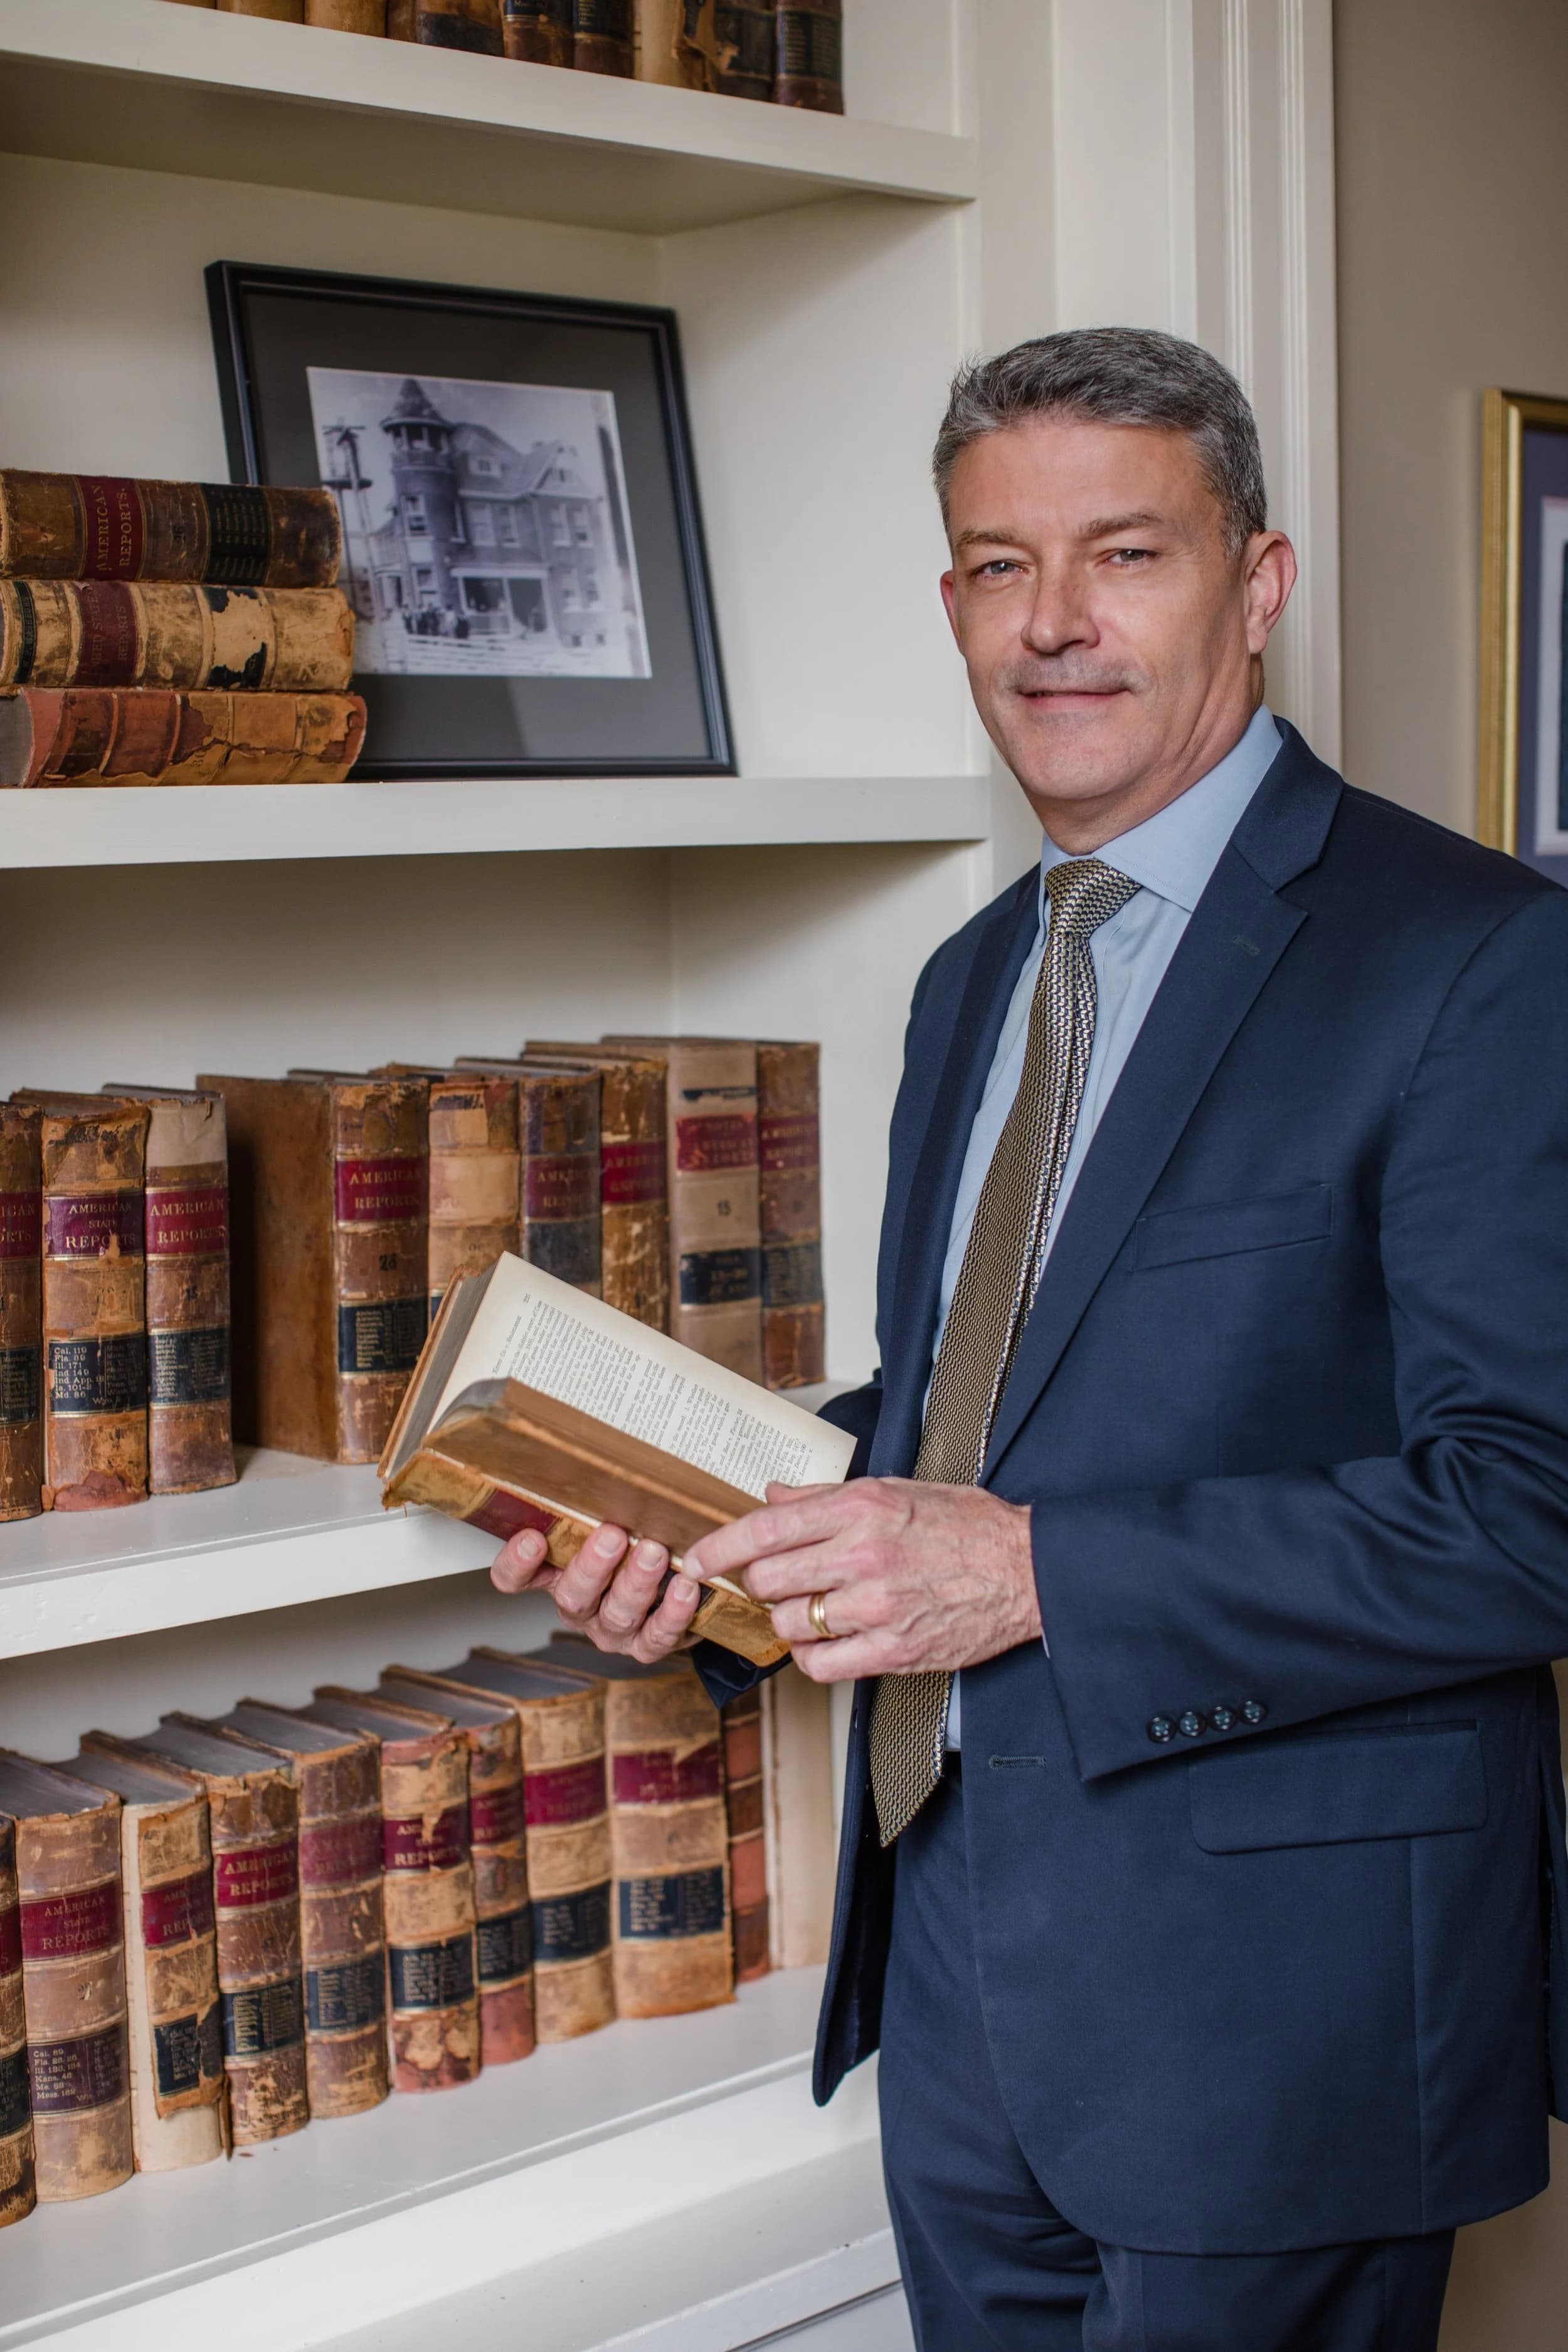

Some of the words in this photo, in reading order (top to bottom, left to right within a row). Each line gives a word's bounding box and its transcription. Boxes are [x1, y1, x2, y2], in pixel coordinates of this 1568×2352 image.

[92, 484, 112, 571] AMERICAN
[68, 1202, 132, 1214] AMERICAN
[151, 1199, 225, 1216] AMERICAN
[65, 1233, 136, 1249] REPOTS
[45, 1896, 105, 1917] AMERICAN
[42, 1925, 111, 1950] REPORTS
